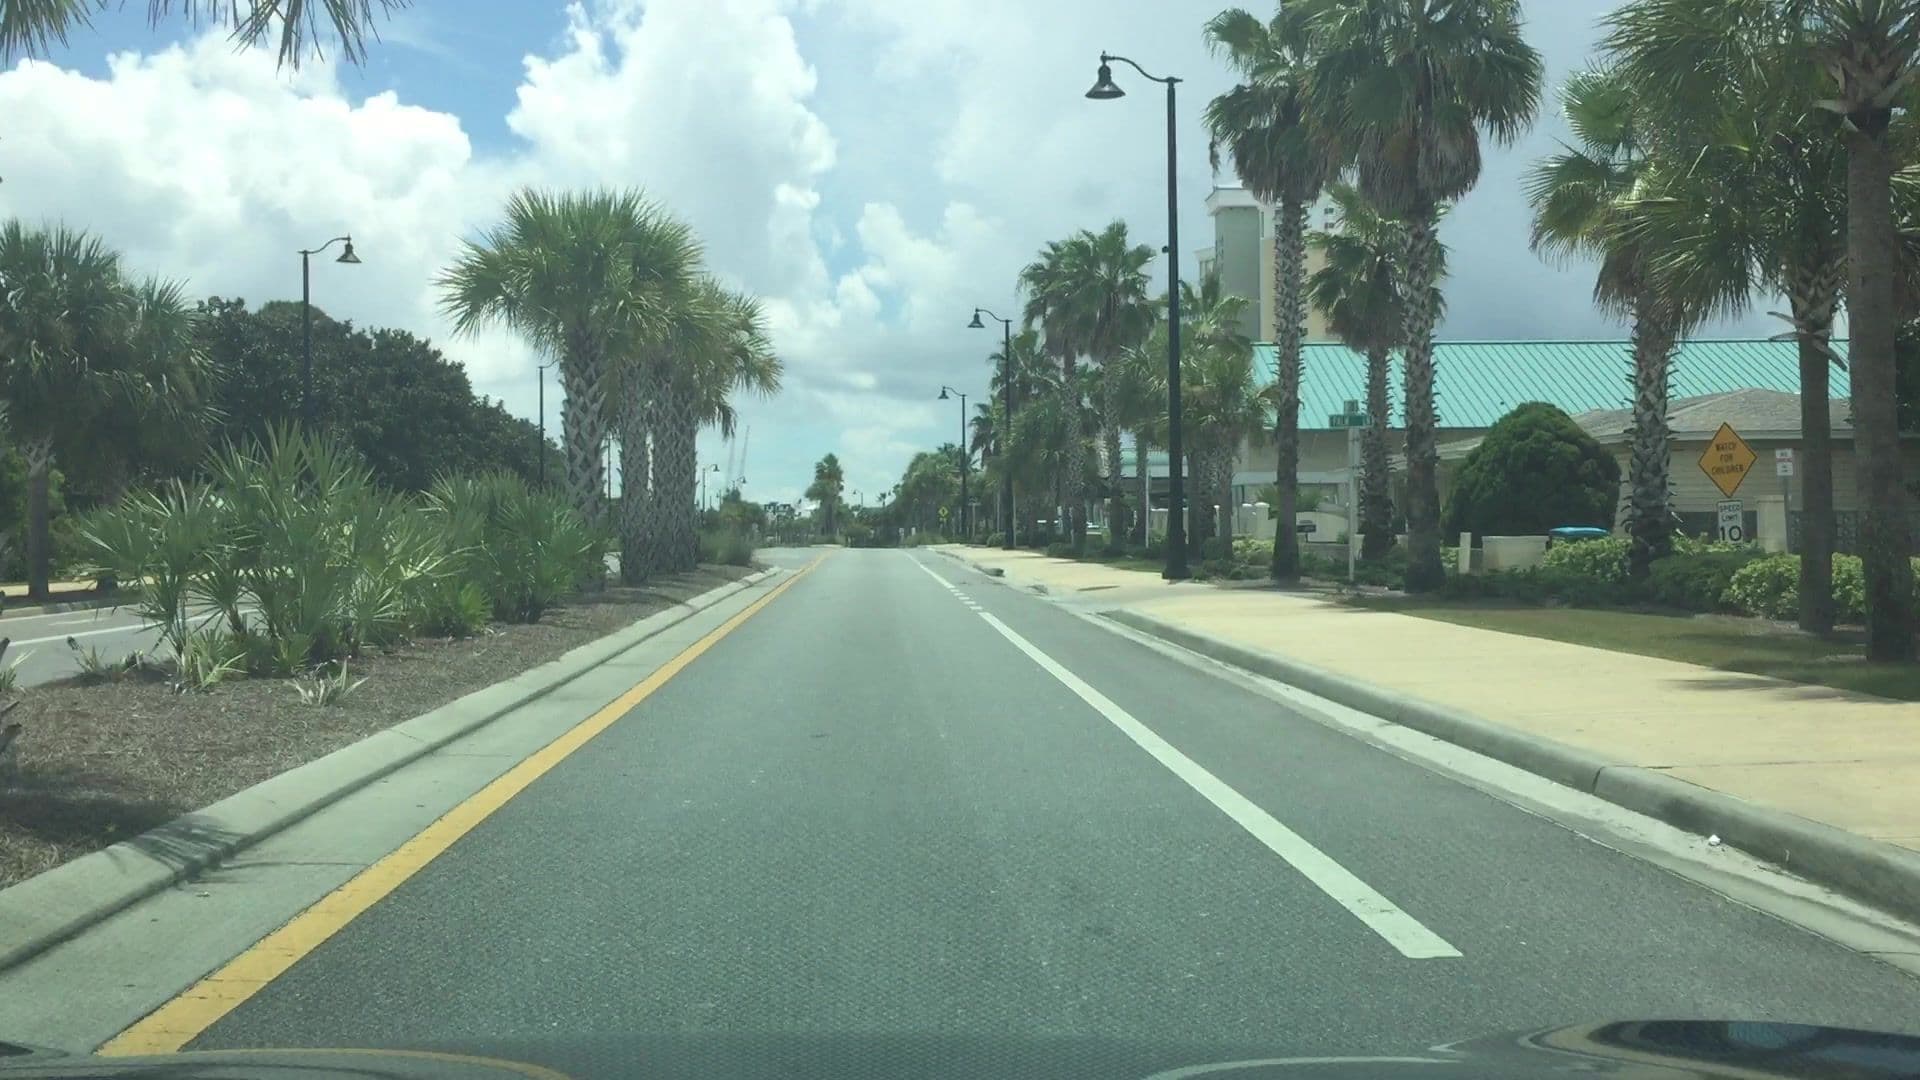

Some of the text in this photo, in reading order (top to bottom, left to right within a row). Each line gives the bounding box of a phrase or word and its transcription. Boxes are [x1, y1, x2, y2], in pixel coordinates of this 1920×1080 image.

[1720, 454, 1733, 462] FOR
[1720, 504, 1740, 512] SPEED
[1720, 525, 1741, 541] 10
